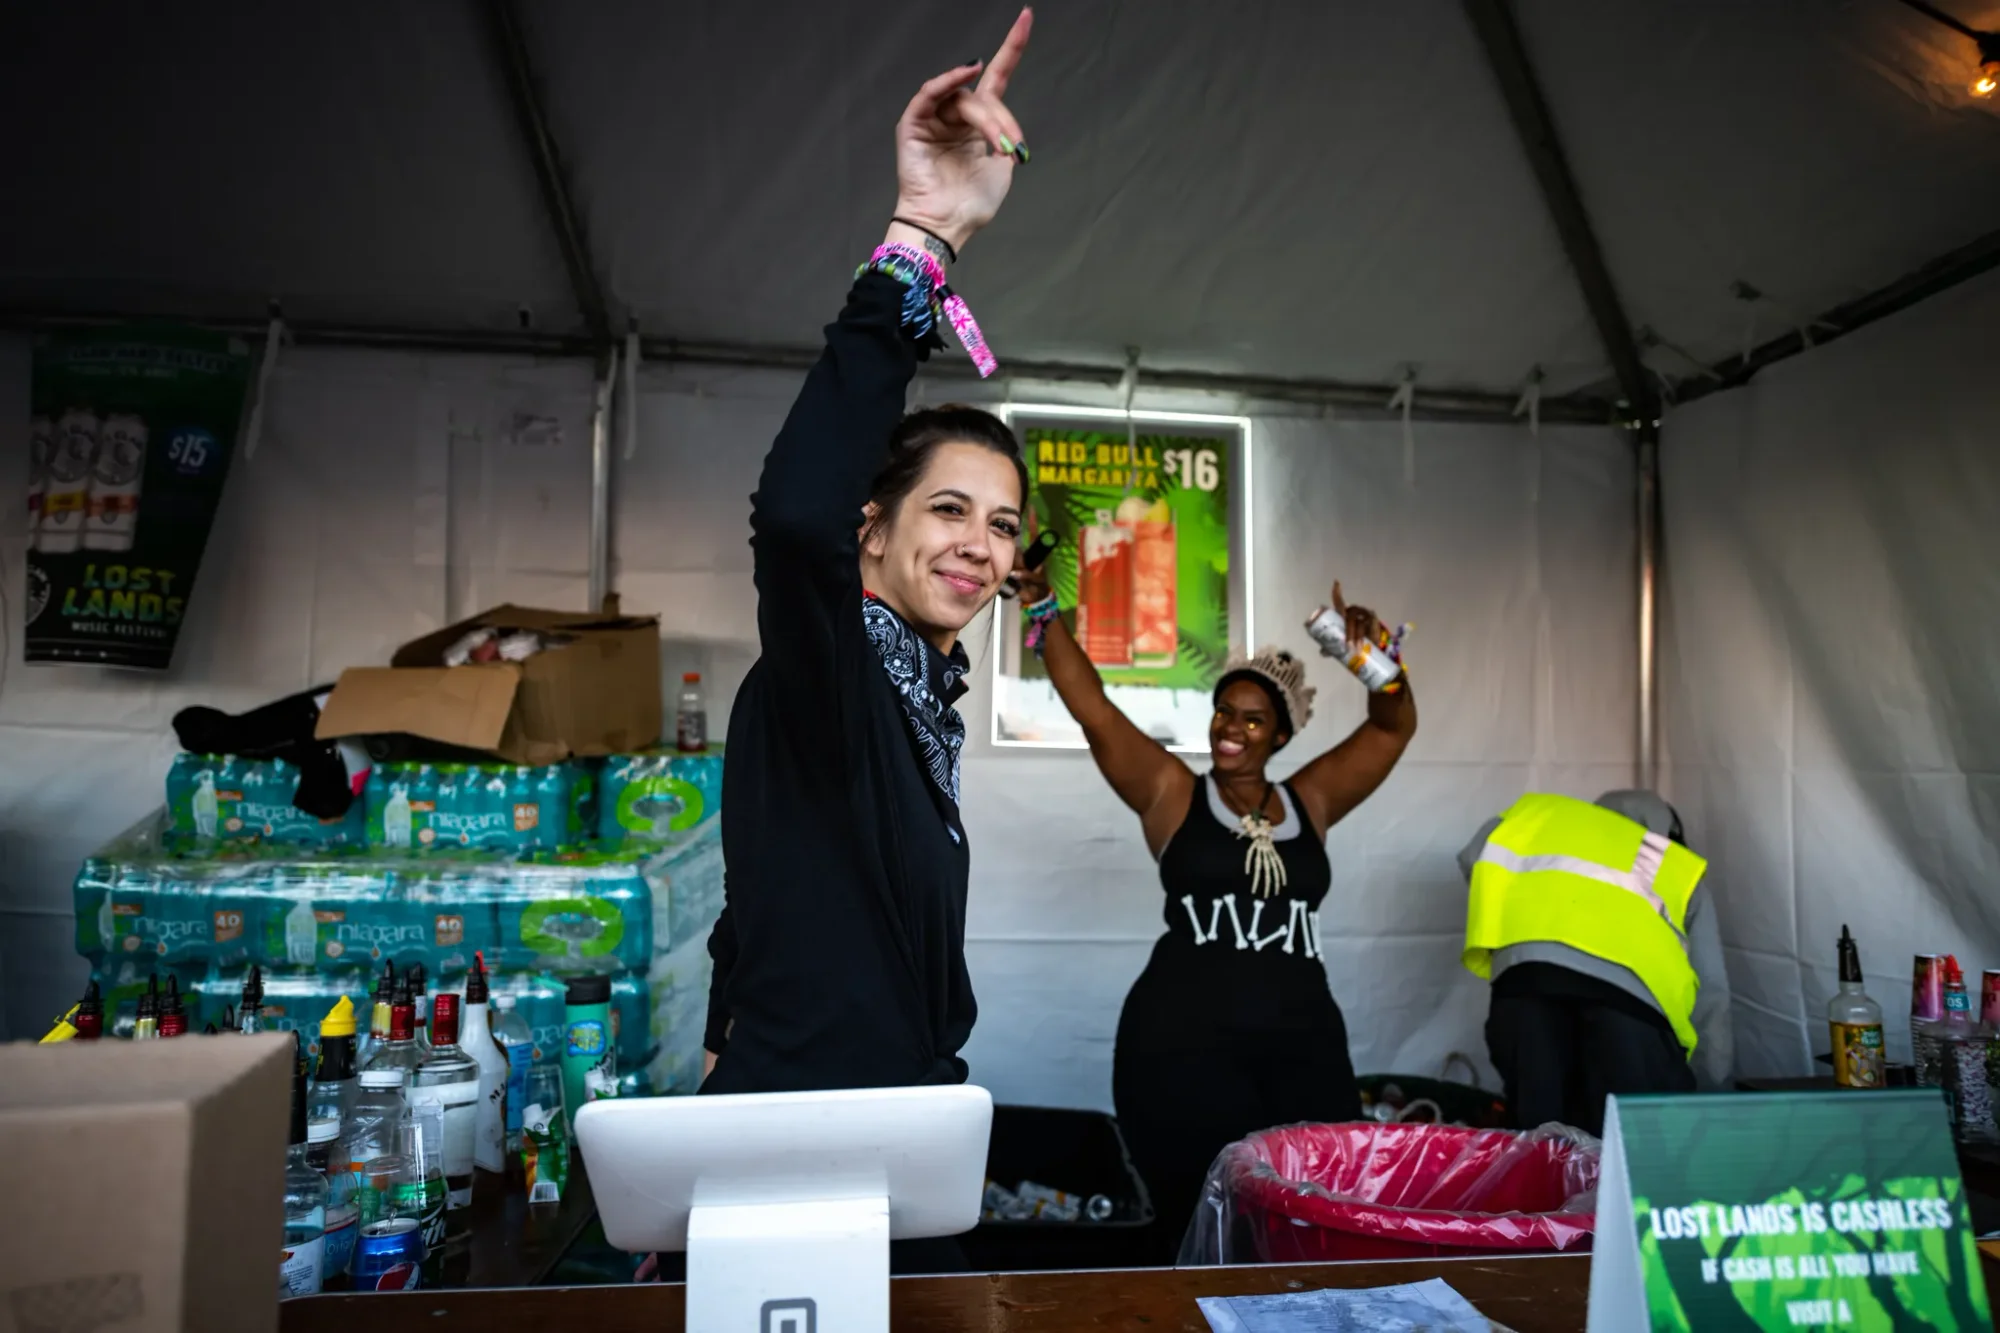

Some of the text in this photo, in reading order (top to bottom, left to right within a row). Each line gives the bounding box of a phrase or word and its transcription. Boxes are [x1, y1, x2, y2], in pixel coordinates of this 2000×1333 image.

[168, 432, 210, 468] $15
[1038, 440, 1158, 468] RED BULL
[1038, 465, 1158, 488] MARGARITA
[1163, 449, 1219, 491] $16
[83, 563, 176, 595] LOST
[61, 586, 184, 624] LANDS
[70, 621, 109, 634] MUSIC
[428, 812, 507, 831] niagara
[215, 914, 241, 927] 40
[336, 923, 425, 944] niagara
[1651, 1197, 1953, 1240] LOST LANDS IS CASHLESS
[1701, 1252, 1920, 1283] IF CASH IS ALL YOU HAVE
[1786, 1299, 1851, 1325] VISIT A
